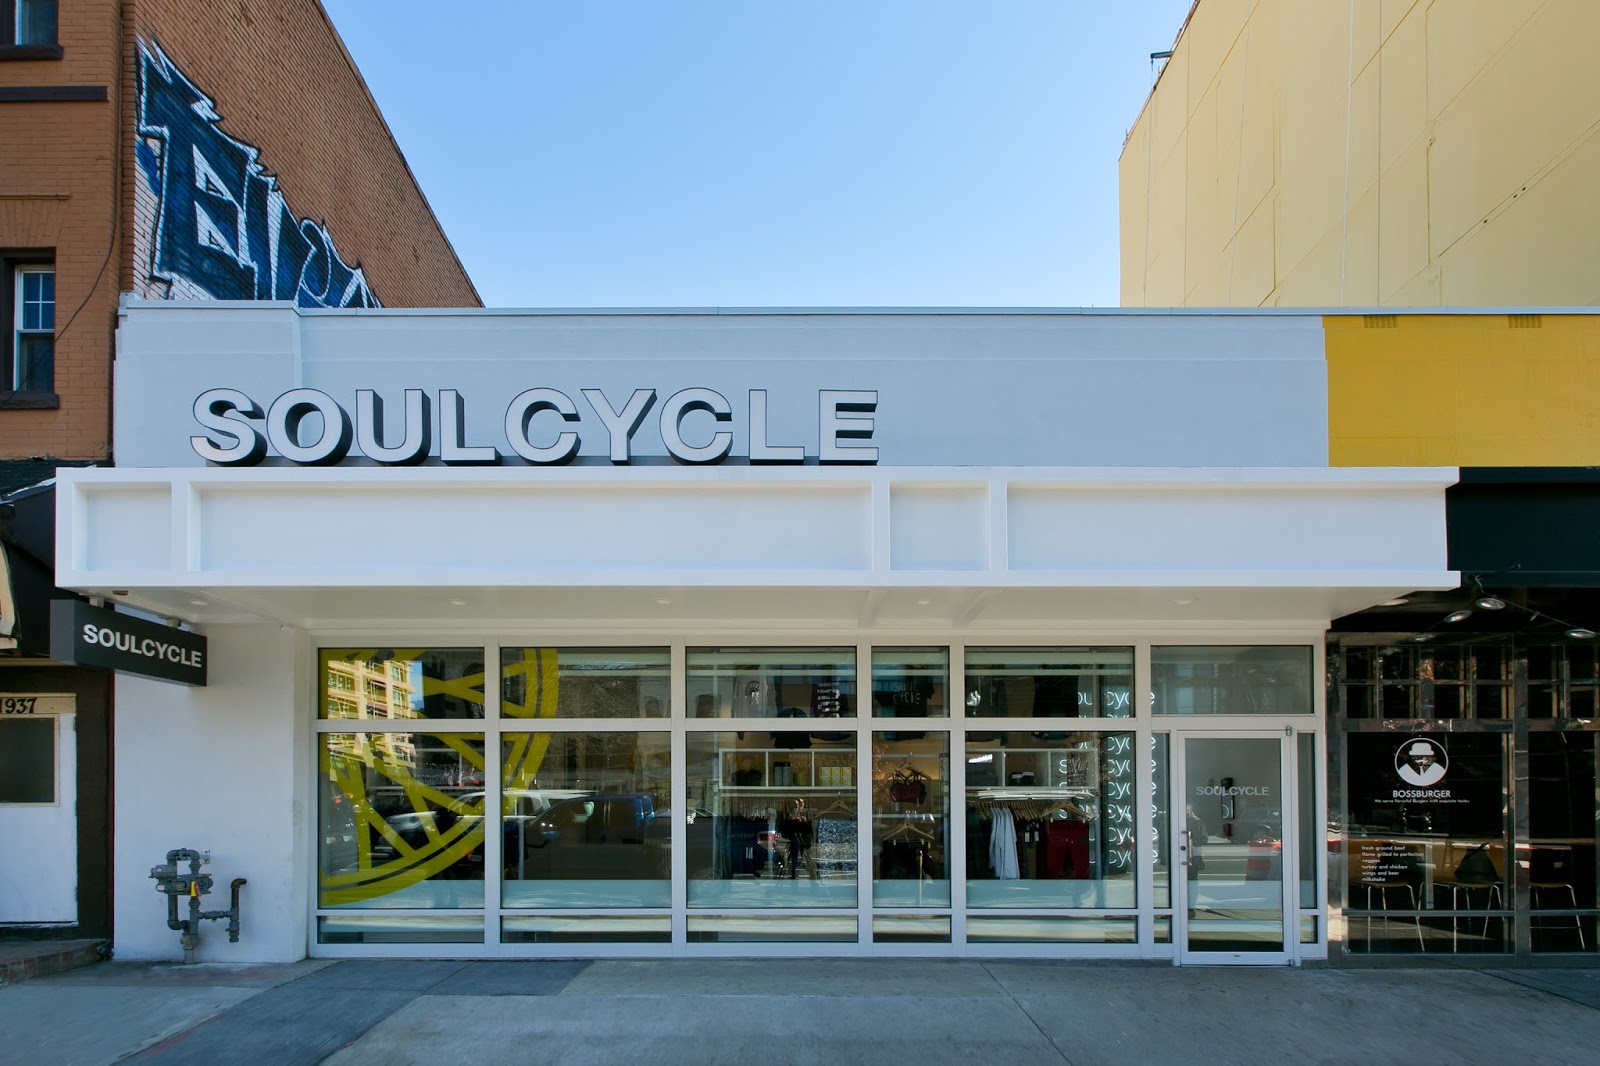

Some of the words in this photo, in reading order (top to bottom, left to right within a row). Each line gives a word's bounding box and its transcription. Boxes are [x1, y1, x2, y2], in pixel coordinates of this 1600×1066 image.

[190, 388, 879, 466] SOULCYCLE
[83, 623, 202, 668] SOULCYCLE
[1196, 786, 1270, 796] SOULCYCLE
[1392, 790, 1451, 798] BOSSBURGER
